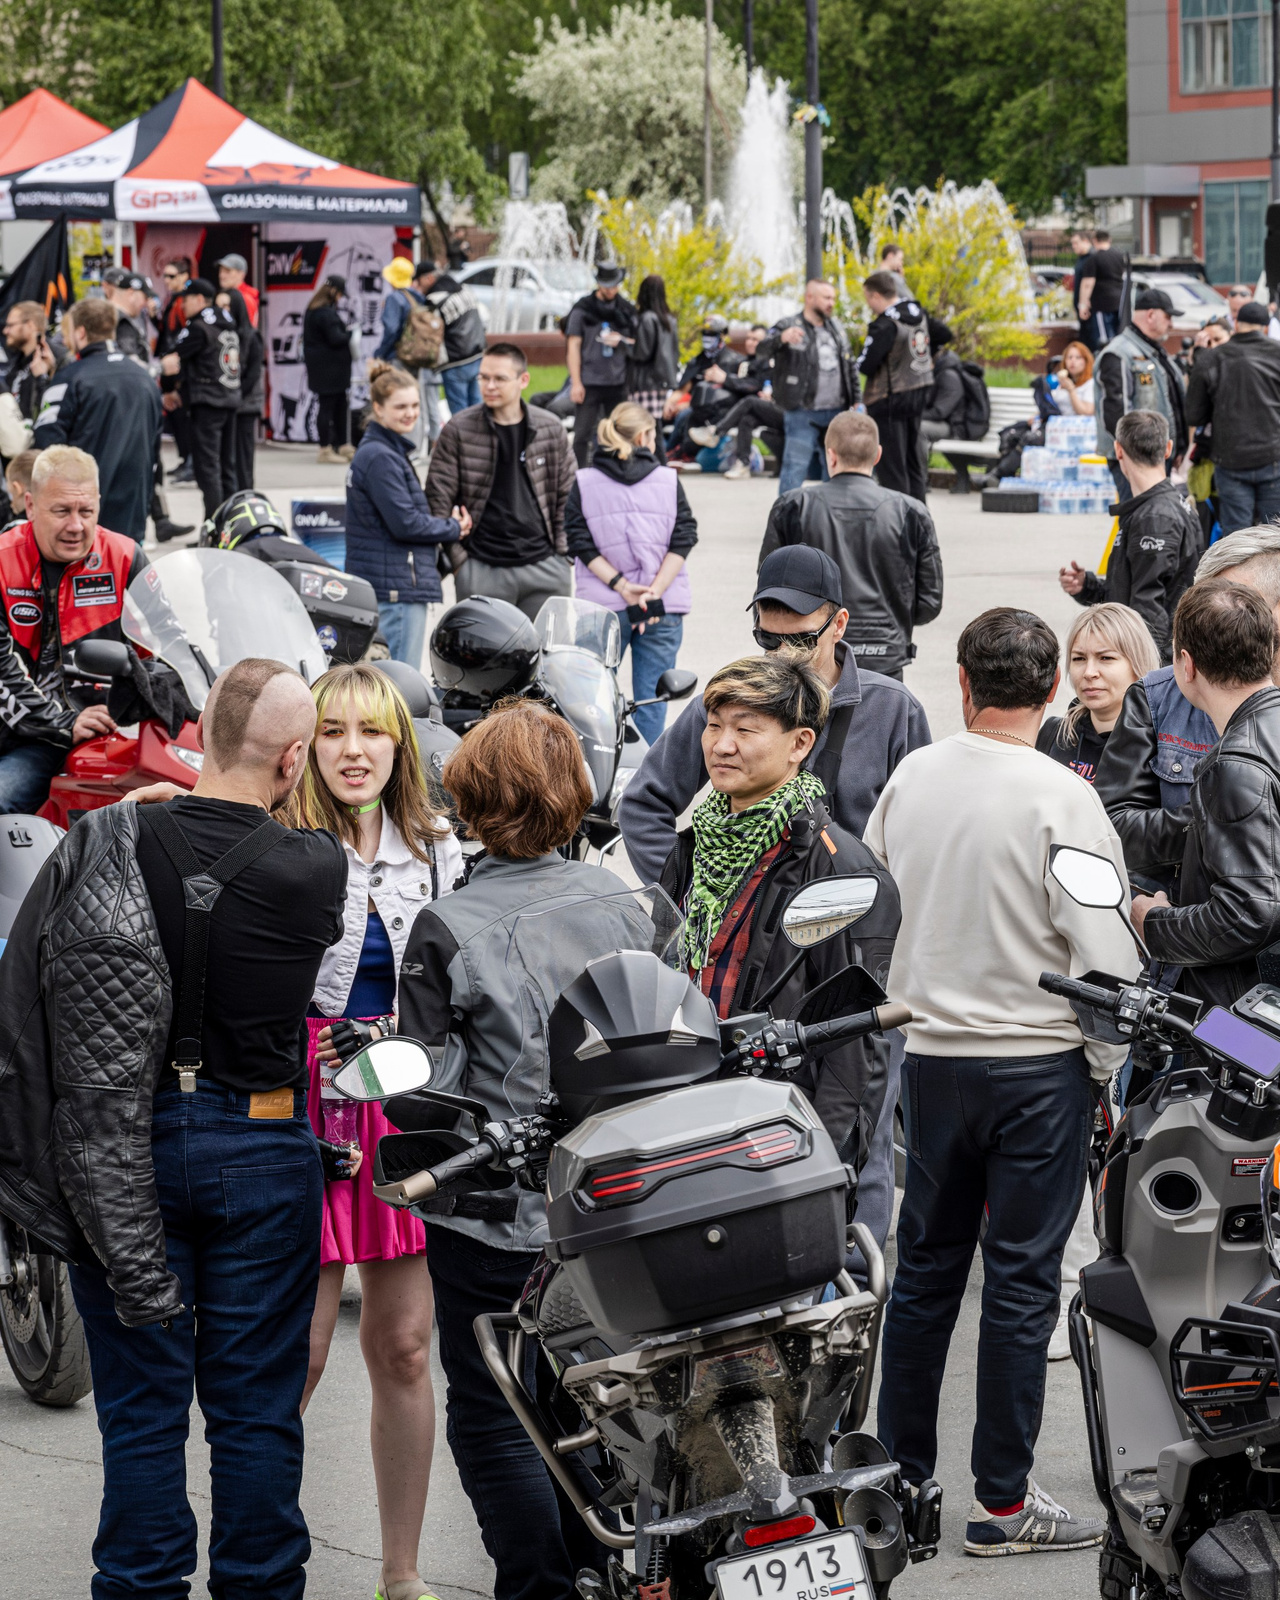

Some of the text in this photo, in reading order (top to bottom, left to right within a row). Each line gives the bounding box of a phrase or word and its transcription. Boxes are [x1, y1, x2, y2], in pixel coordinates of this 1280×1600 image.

[221, 194, 408, 213] СМАЗОЧНЫЕ МАТЕРИАЛЫ
[743, 1544, 841, 1596] 1913
[797, 1585, 829, 1600] RUS
